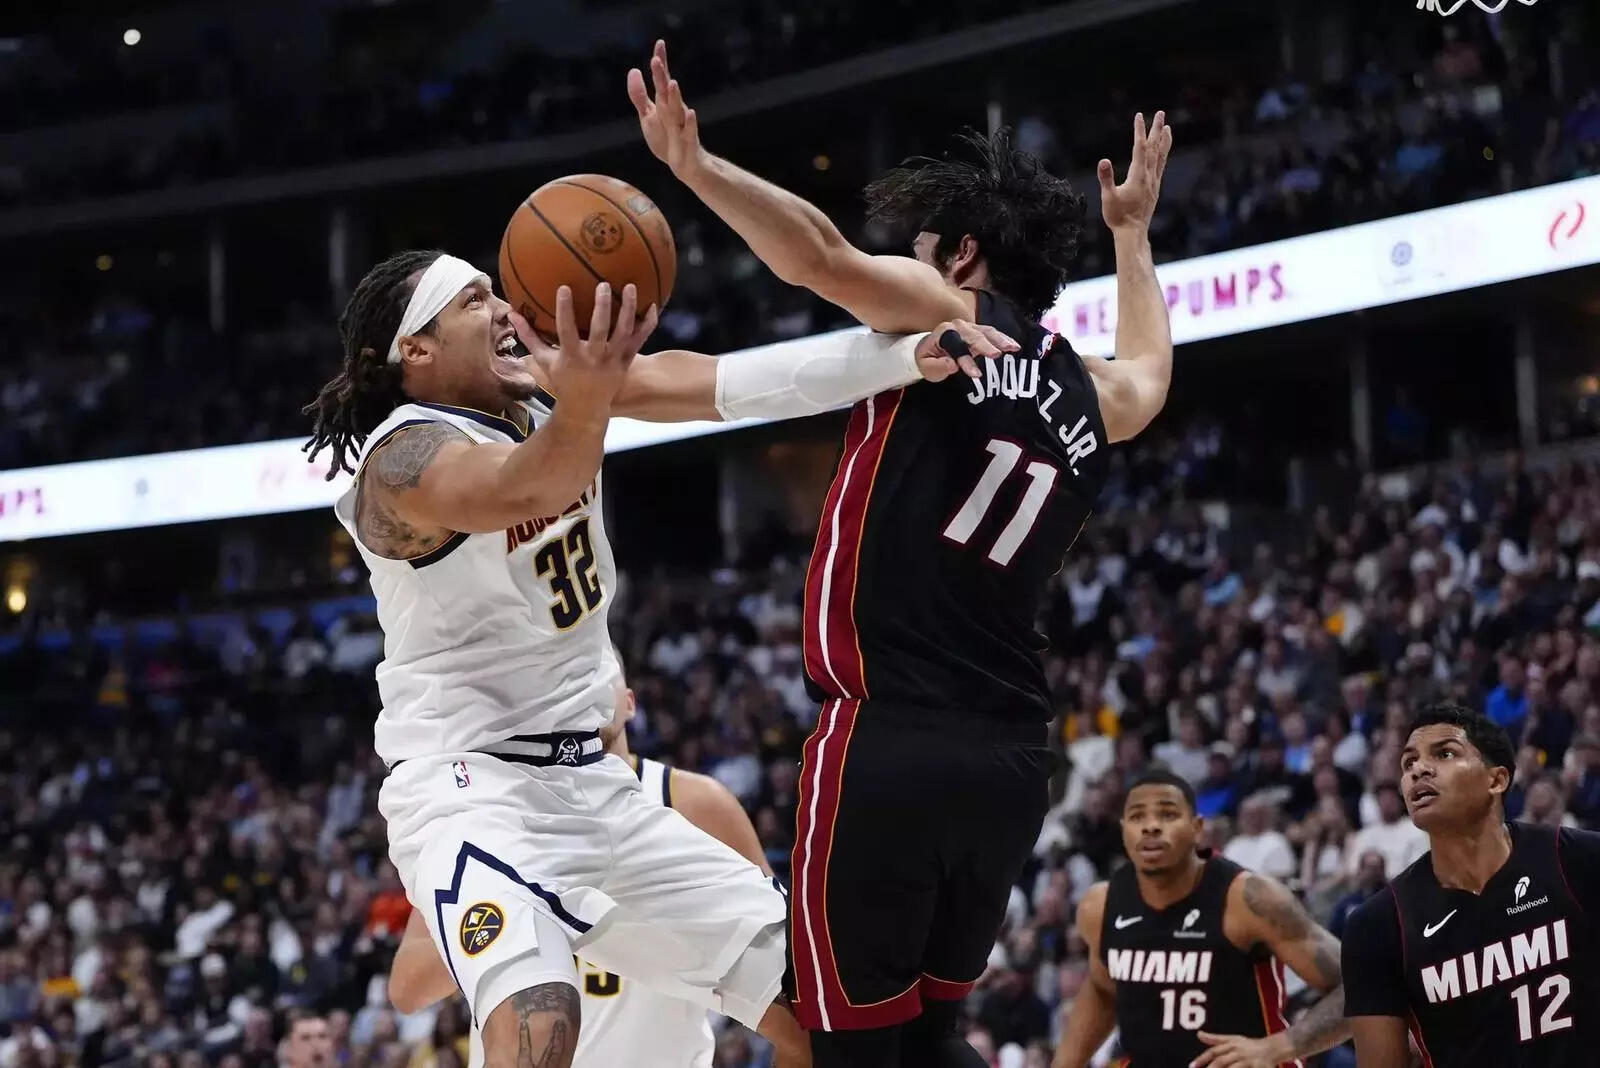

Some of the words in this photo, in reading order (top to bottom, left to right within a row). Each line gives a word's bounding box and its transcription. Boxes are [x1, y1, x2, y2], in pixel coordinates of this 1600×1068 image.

[967, 354, 1062, 423] JAQUZ
[1059, 415, 1097, 476] JR.
[942, 438, 1058, 567] 11
[534, 515, 604, 631] 32
[1506, 895, 1549, 916] Robinhood
[1107, 948, 1213, 983] MIAMI
[1421, 919, 1569, 1003] MIAMI
[1160, 989, 1207, 1031] 16
[1510, 973, 1573, 1042] 12
